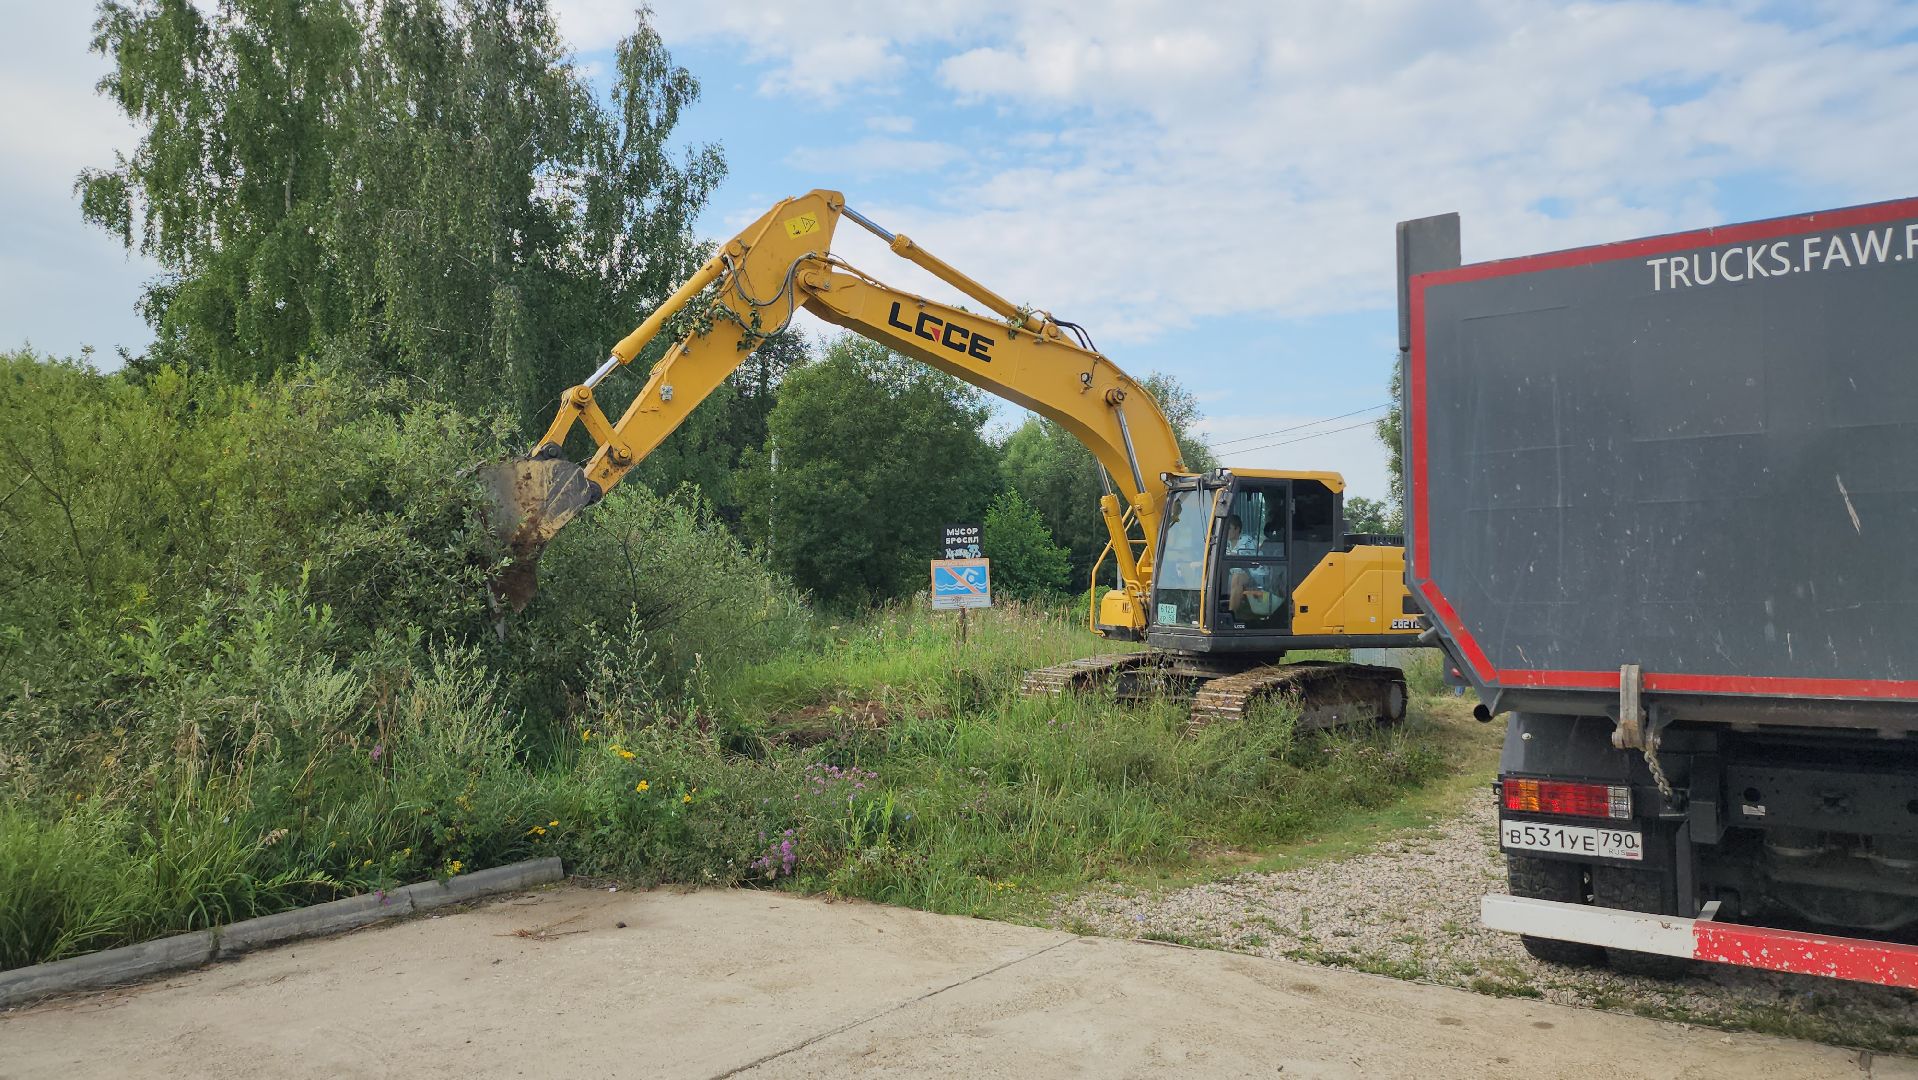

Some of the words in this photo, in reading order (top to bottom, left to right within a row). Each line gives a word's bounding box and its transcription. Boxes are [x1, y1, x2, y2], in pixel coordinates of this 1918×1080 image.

[888, 301, 995, 363] LGCE
[946, 527, 979, 536] МУСОР
[945, 536, 979, 545] БРОСИЛ
[1601, 832, 1636, 848] 790
